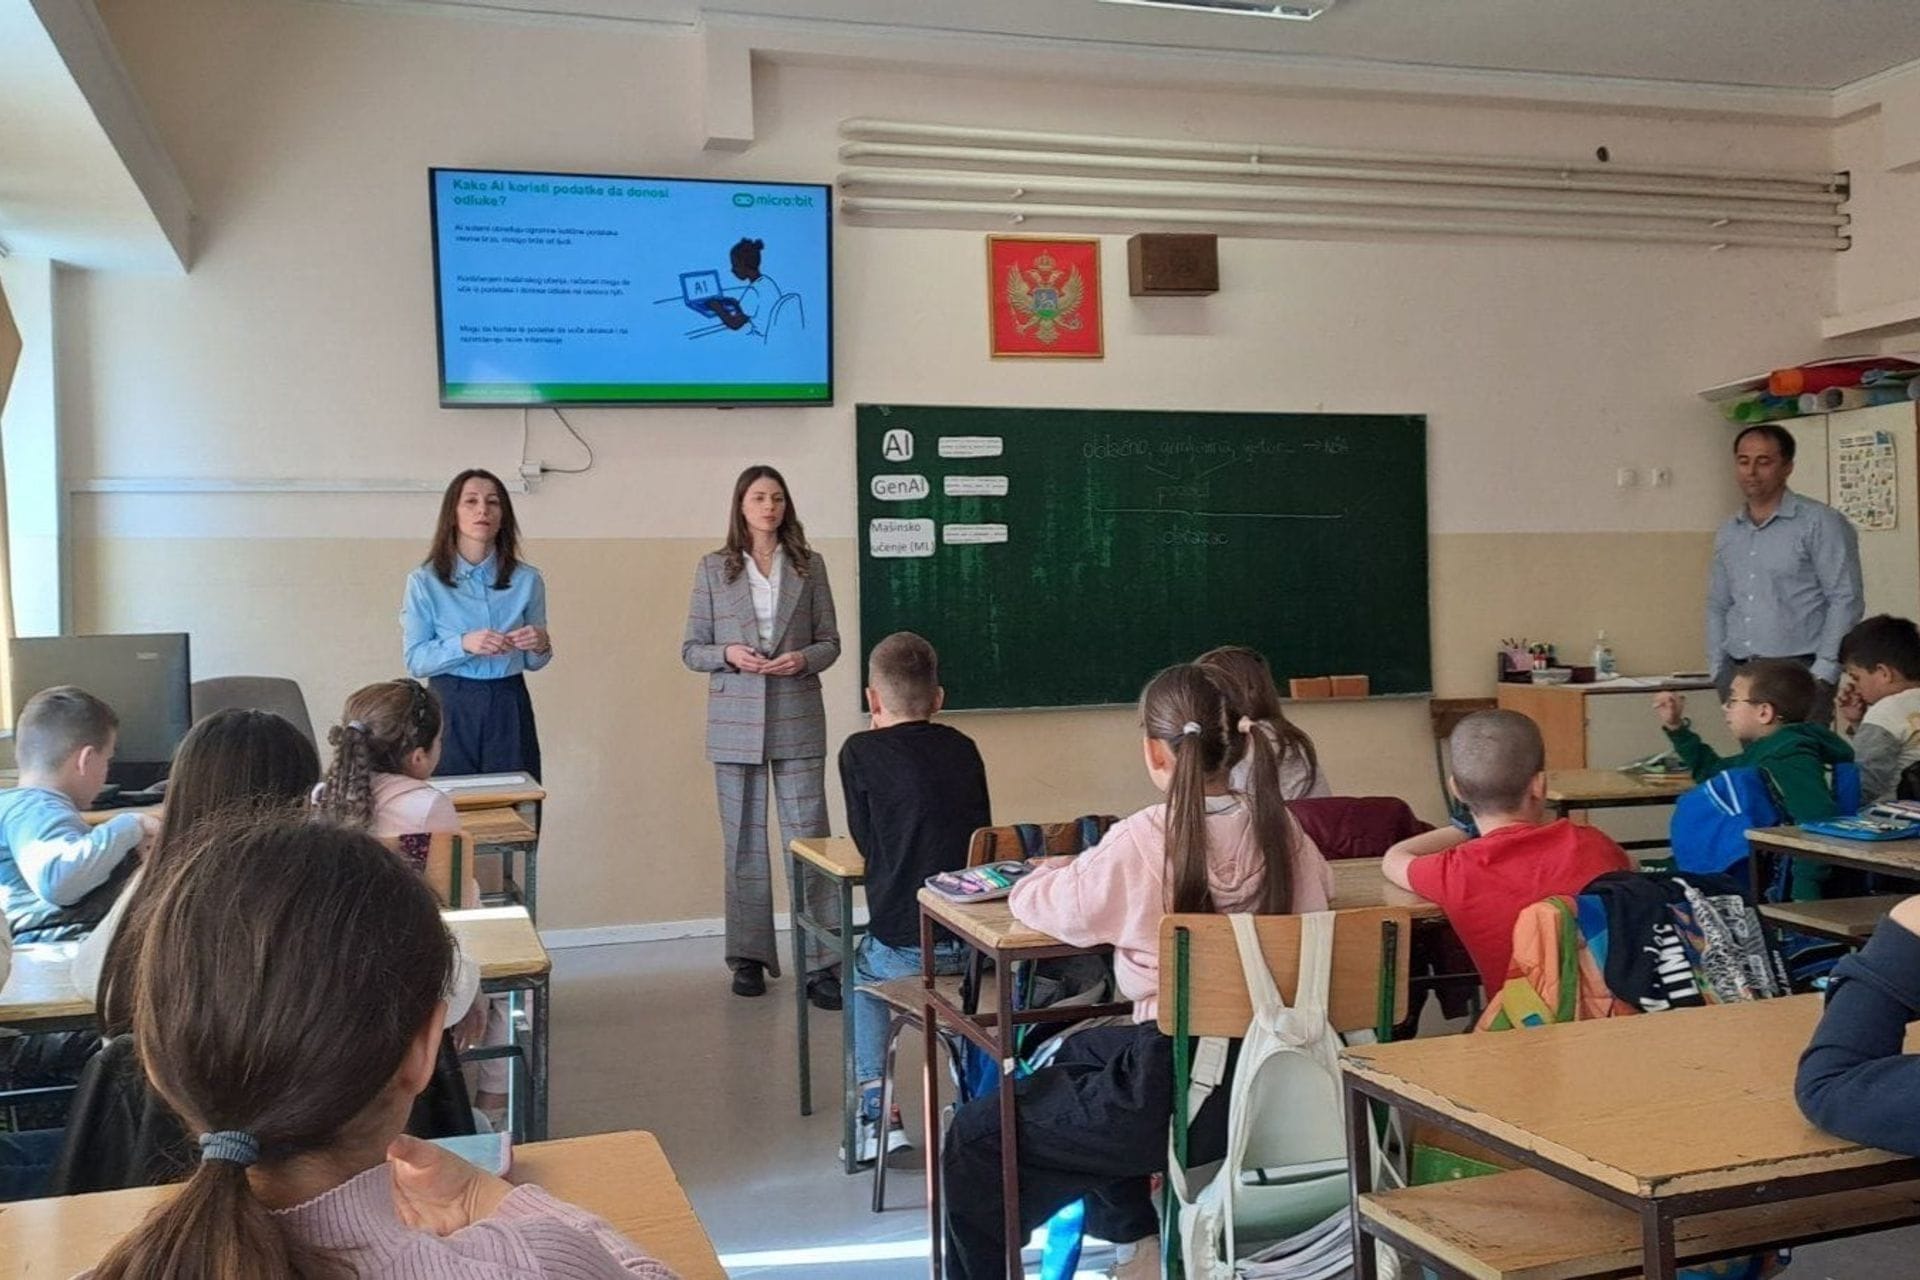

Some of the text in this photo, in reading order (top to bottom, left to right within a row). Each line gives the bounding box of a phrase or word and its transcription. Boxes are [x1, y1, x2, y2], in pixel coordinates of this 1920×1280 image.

[453, 179, 669, 198] Kako AI koristi podatke da donosi
[454, 195, 507, 206] odluke?
[756, 193, 813, 207] micro:bit
[695, 280, 708, 296] AI
[885, 433, 910, 457] AI
[874, 478, 925, 495] GenAI
[871, 522, 921, 532] Mašinsko
